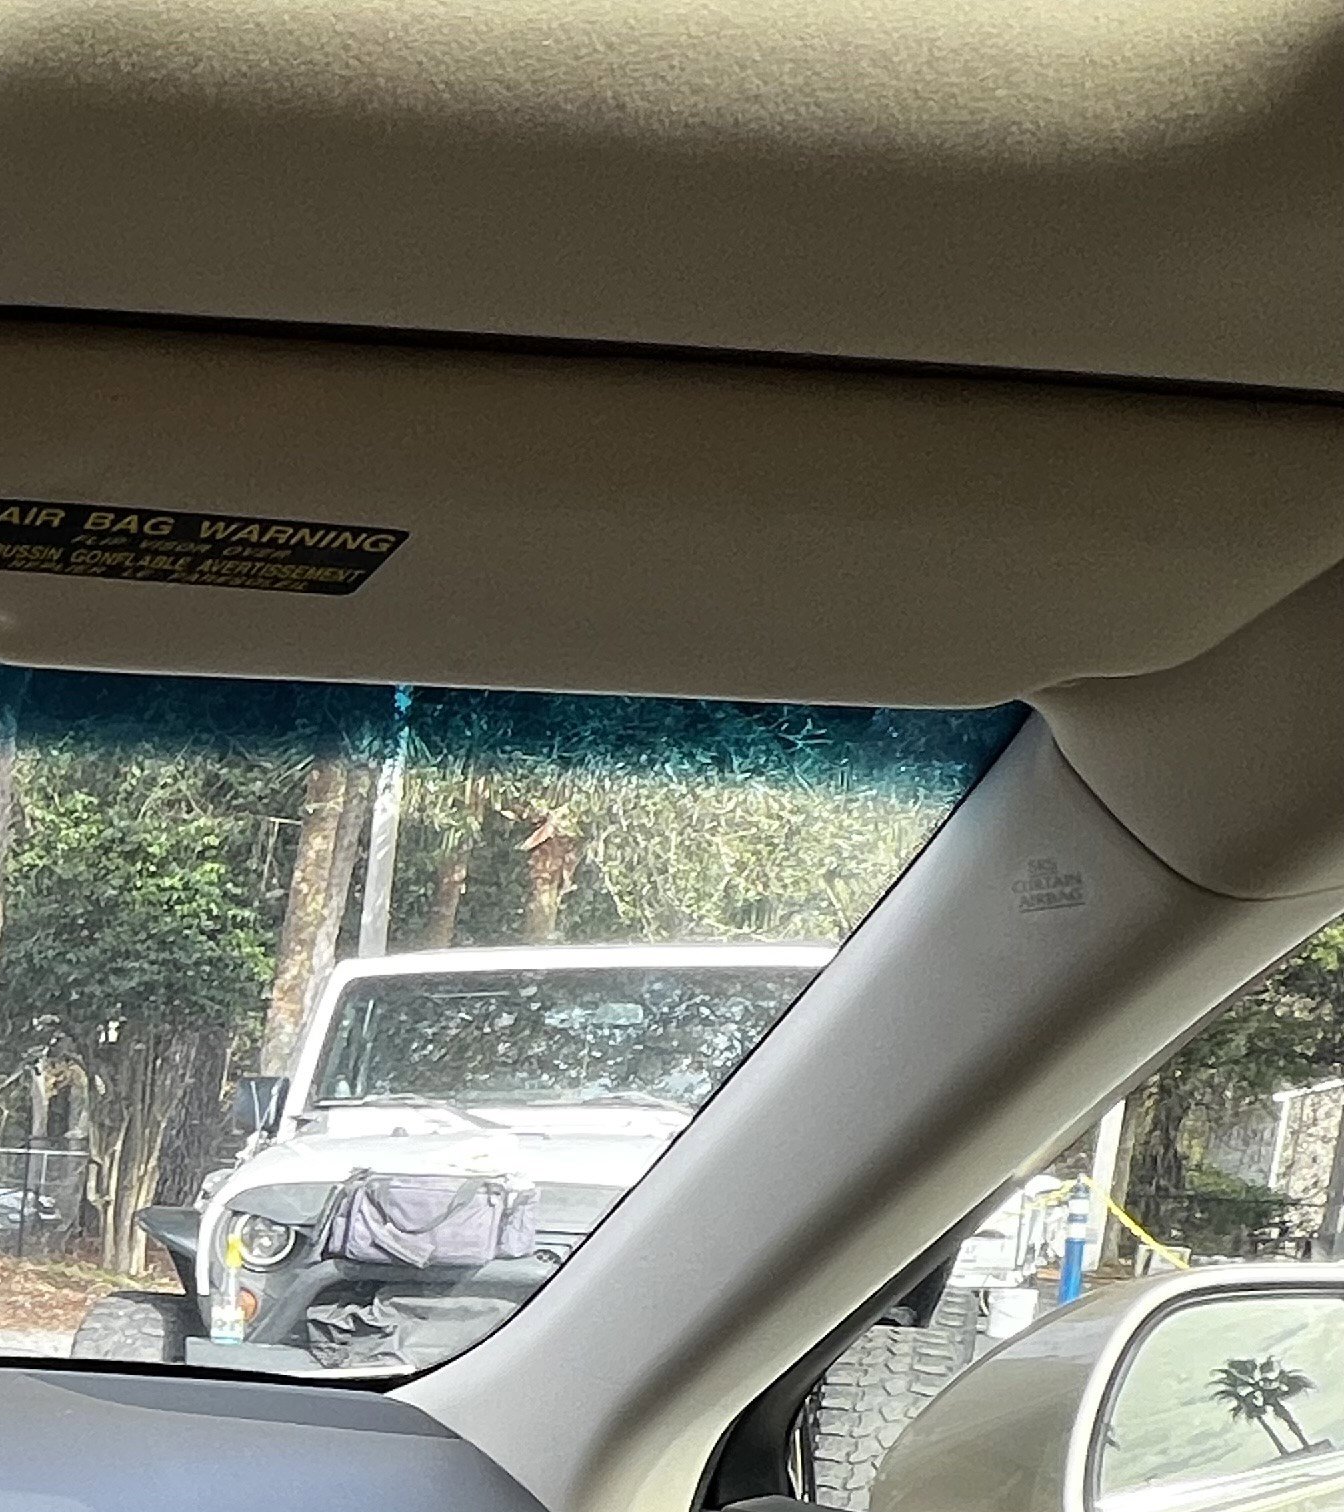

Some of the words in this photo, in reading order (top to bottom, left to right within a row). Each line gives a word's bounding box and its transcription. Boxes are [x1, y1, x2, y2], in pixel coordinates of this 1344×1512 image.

[83, 511, 176, 536] BAG
[199, 519, 397, 553] WARNING
[70, 548, 194, 571] GONFLABLE
